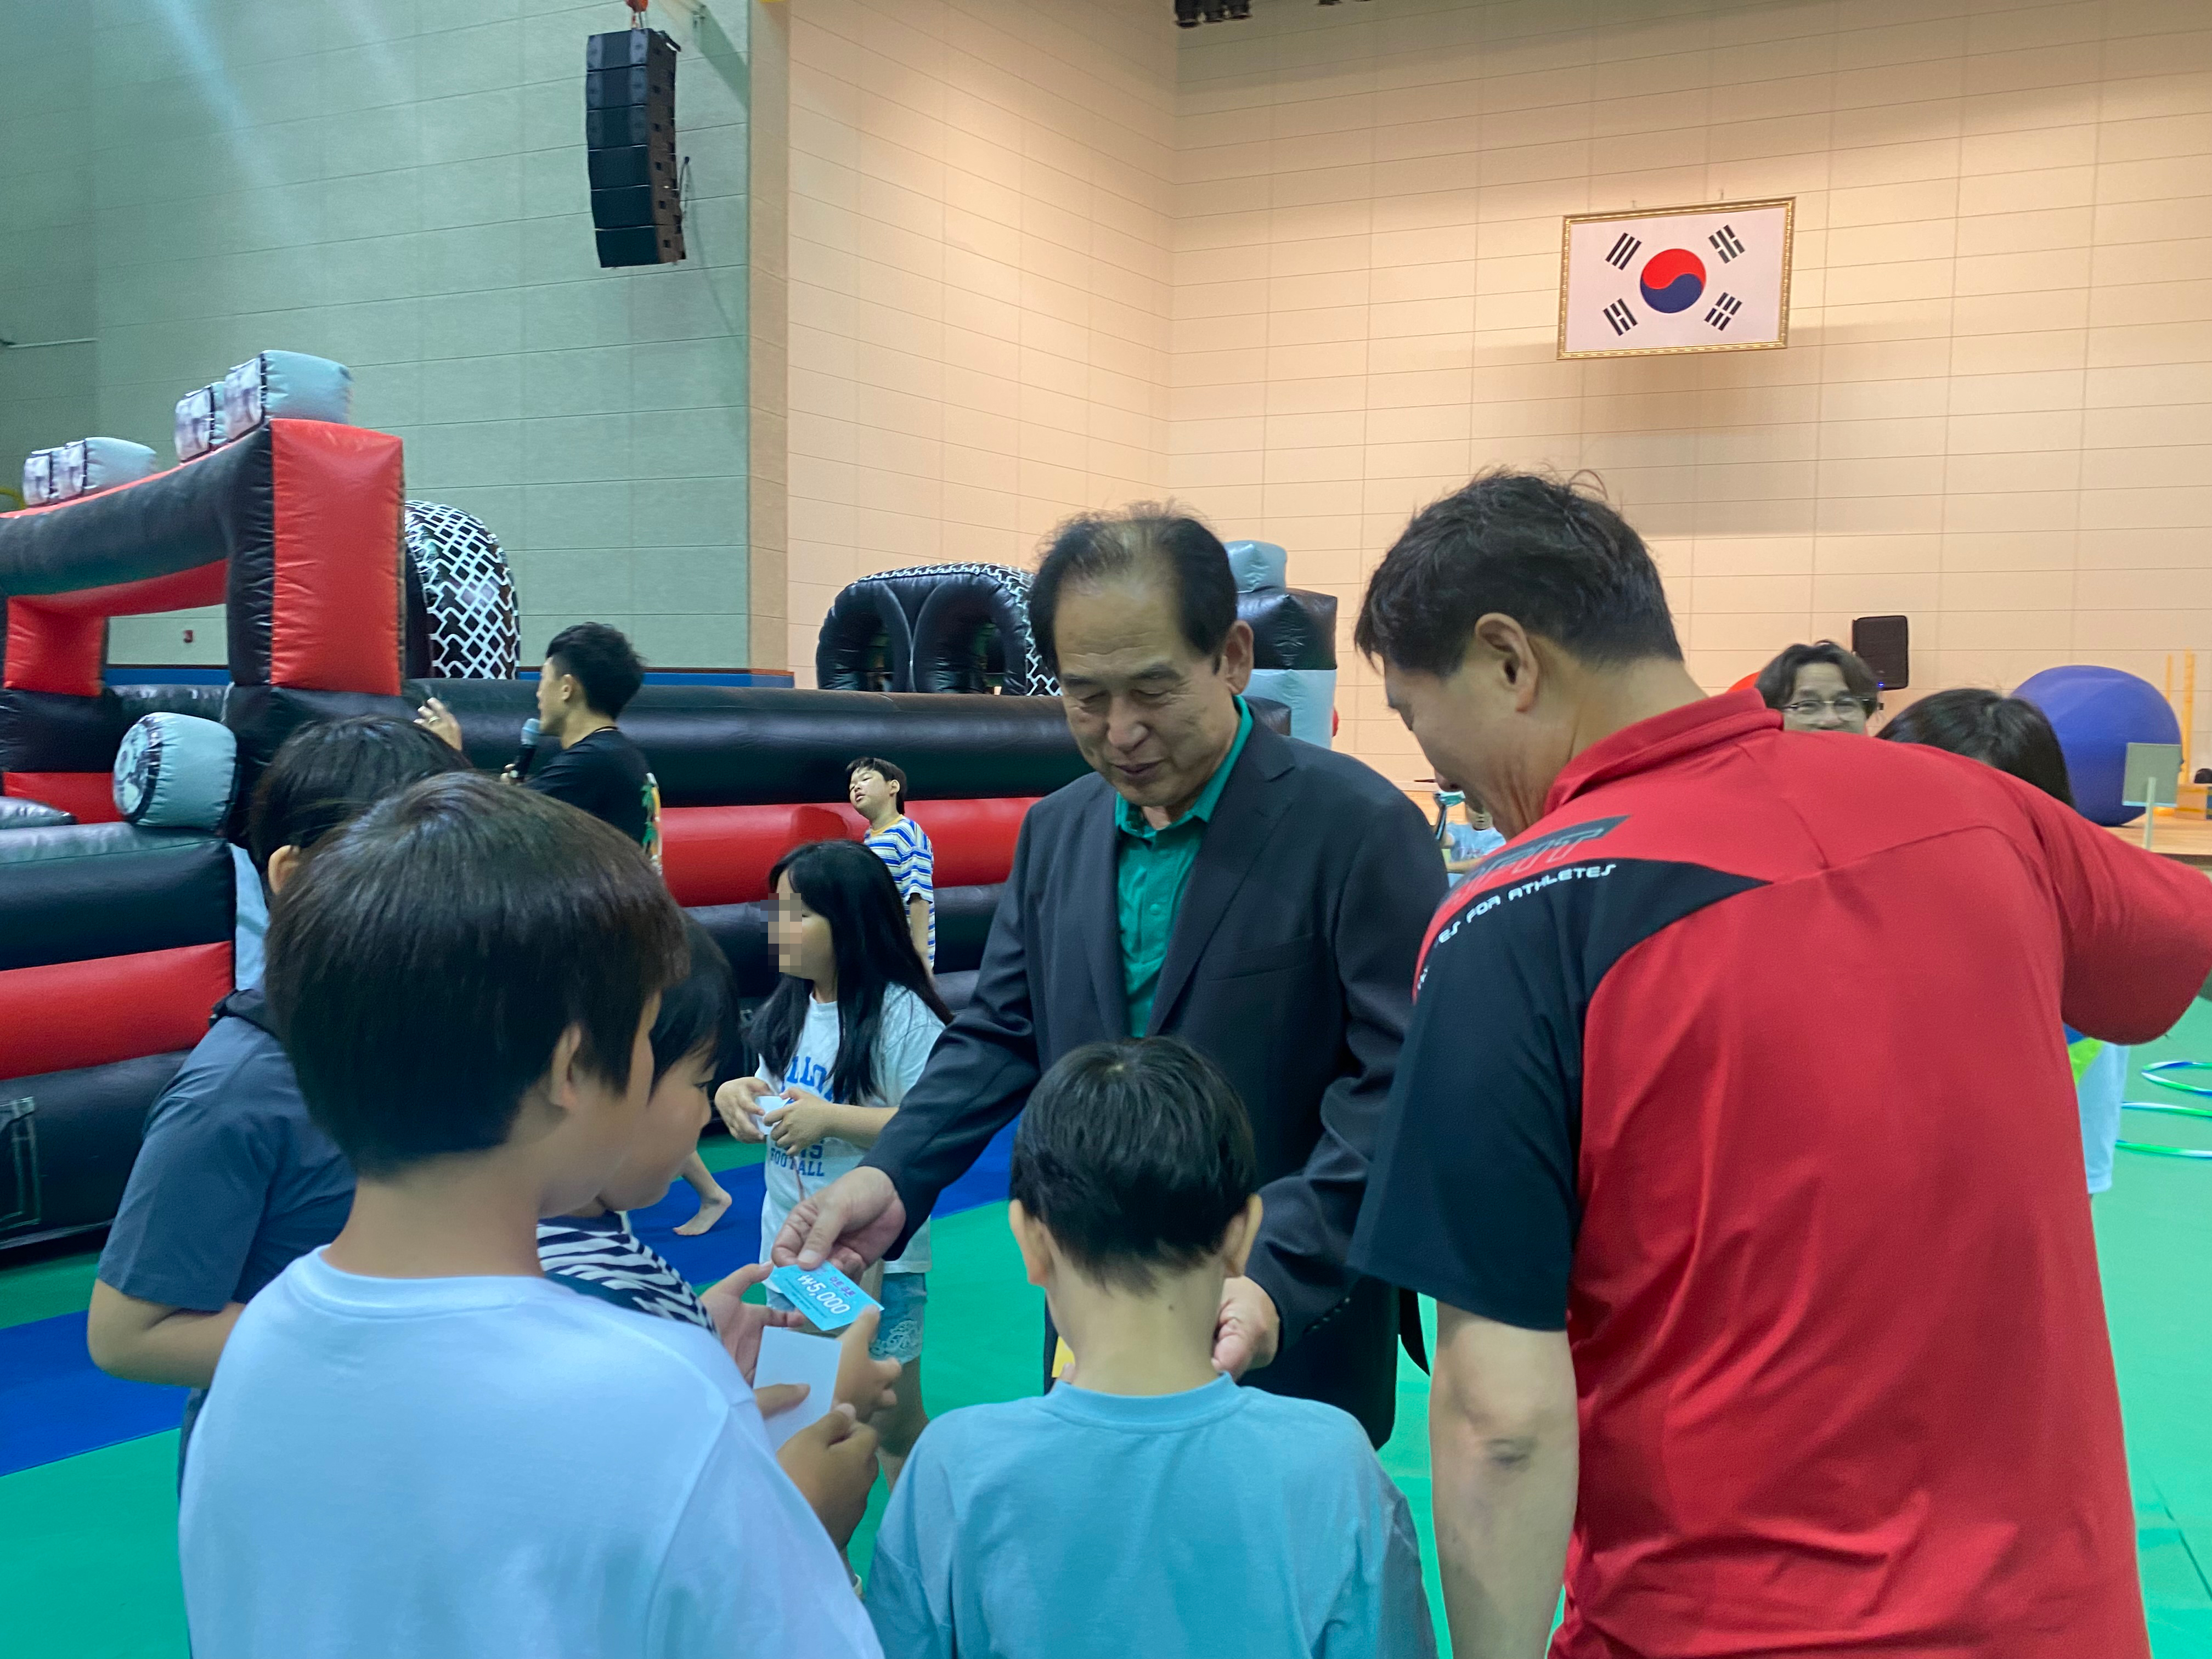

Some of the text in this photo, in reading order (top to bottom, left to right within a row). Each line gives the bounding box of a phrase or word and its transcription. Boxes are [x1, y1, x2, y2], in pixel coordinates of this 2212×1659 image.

[1435, 863, 1617, 946] ES FOR ATHLETES
[770, 1147, 825, 1177] FOOTALL
